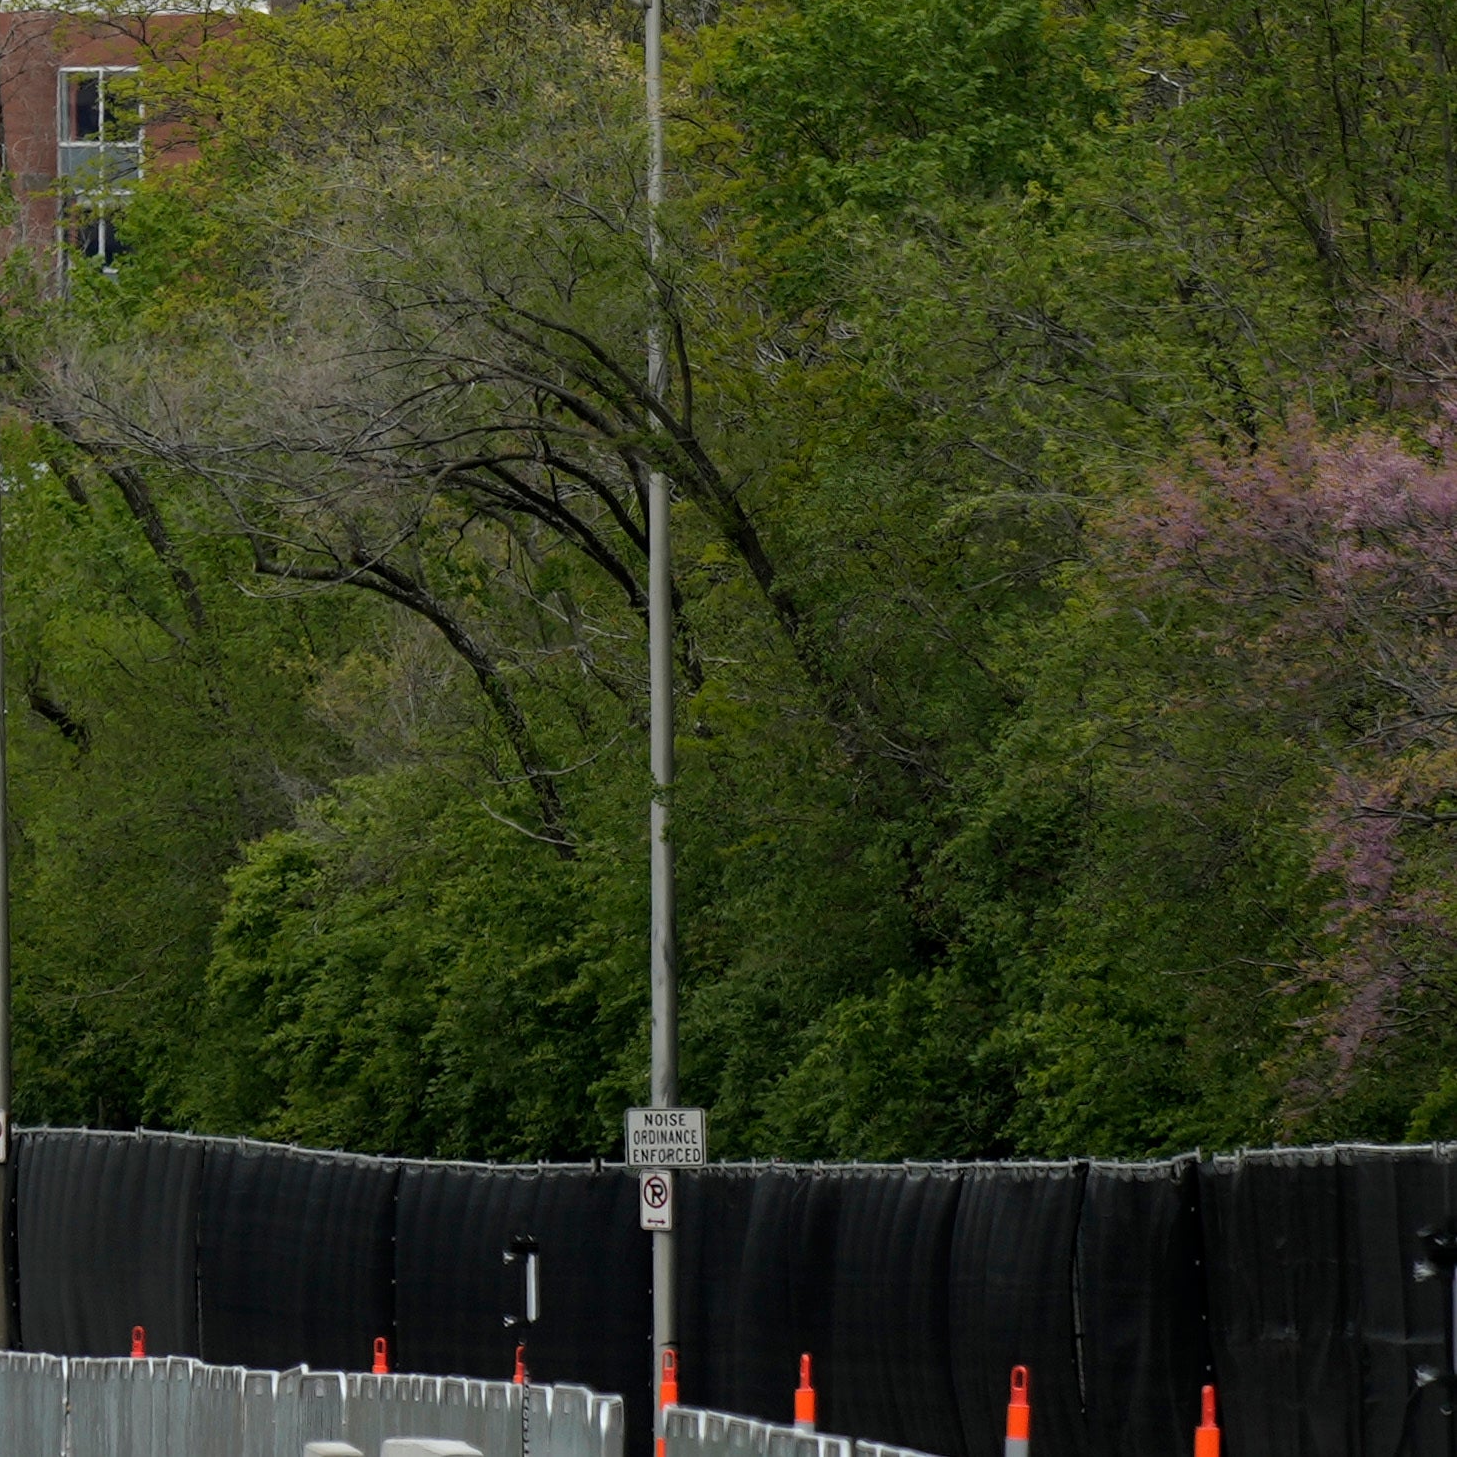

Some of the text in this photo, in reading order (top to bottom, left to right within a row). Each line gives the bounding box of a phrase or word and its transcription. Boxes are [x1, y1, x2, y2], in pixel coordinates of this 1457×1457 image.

[644, 1114, 686, 1127] NOISE
[633, 1129, 697, 1145] ORDINANCE
[633, 1148, 701, 1164] ENFORCED
